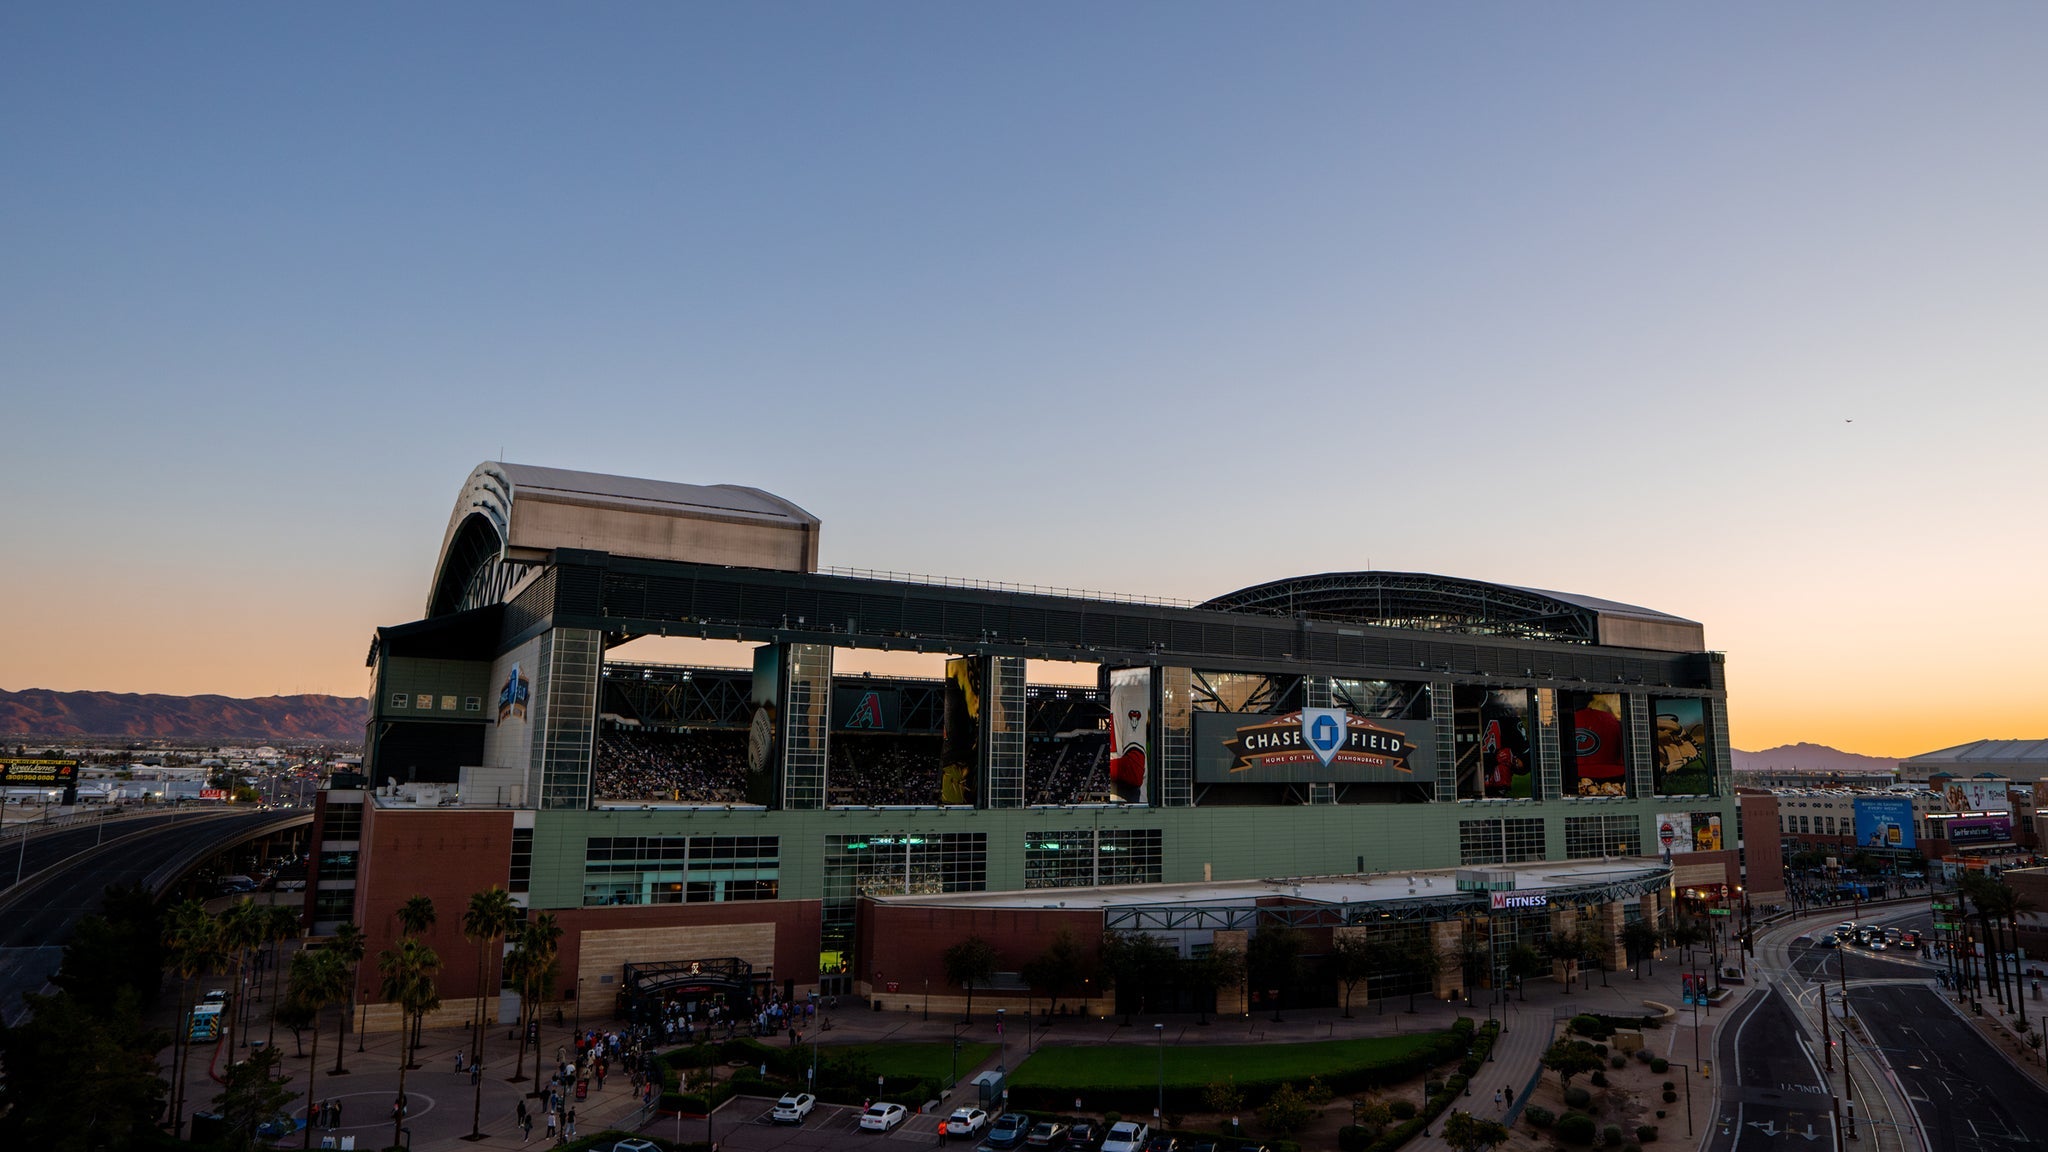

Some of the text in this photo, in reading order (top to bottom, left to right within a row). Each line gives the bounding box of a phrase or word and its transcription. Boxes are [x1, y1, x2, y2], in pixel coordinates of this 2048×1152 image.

[1244, 731, 1401, 752] CHASE FIELD
[1265, 756, 1285, 764] HOME
[1337, 755, 1384, 765] DIAMONDBACKS
[1505, 895, 1547, 908] FITNESS
